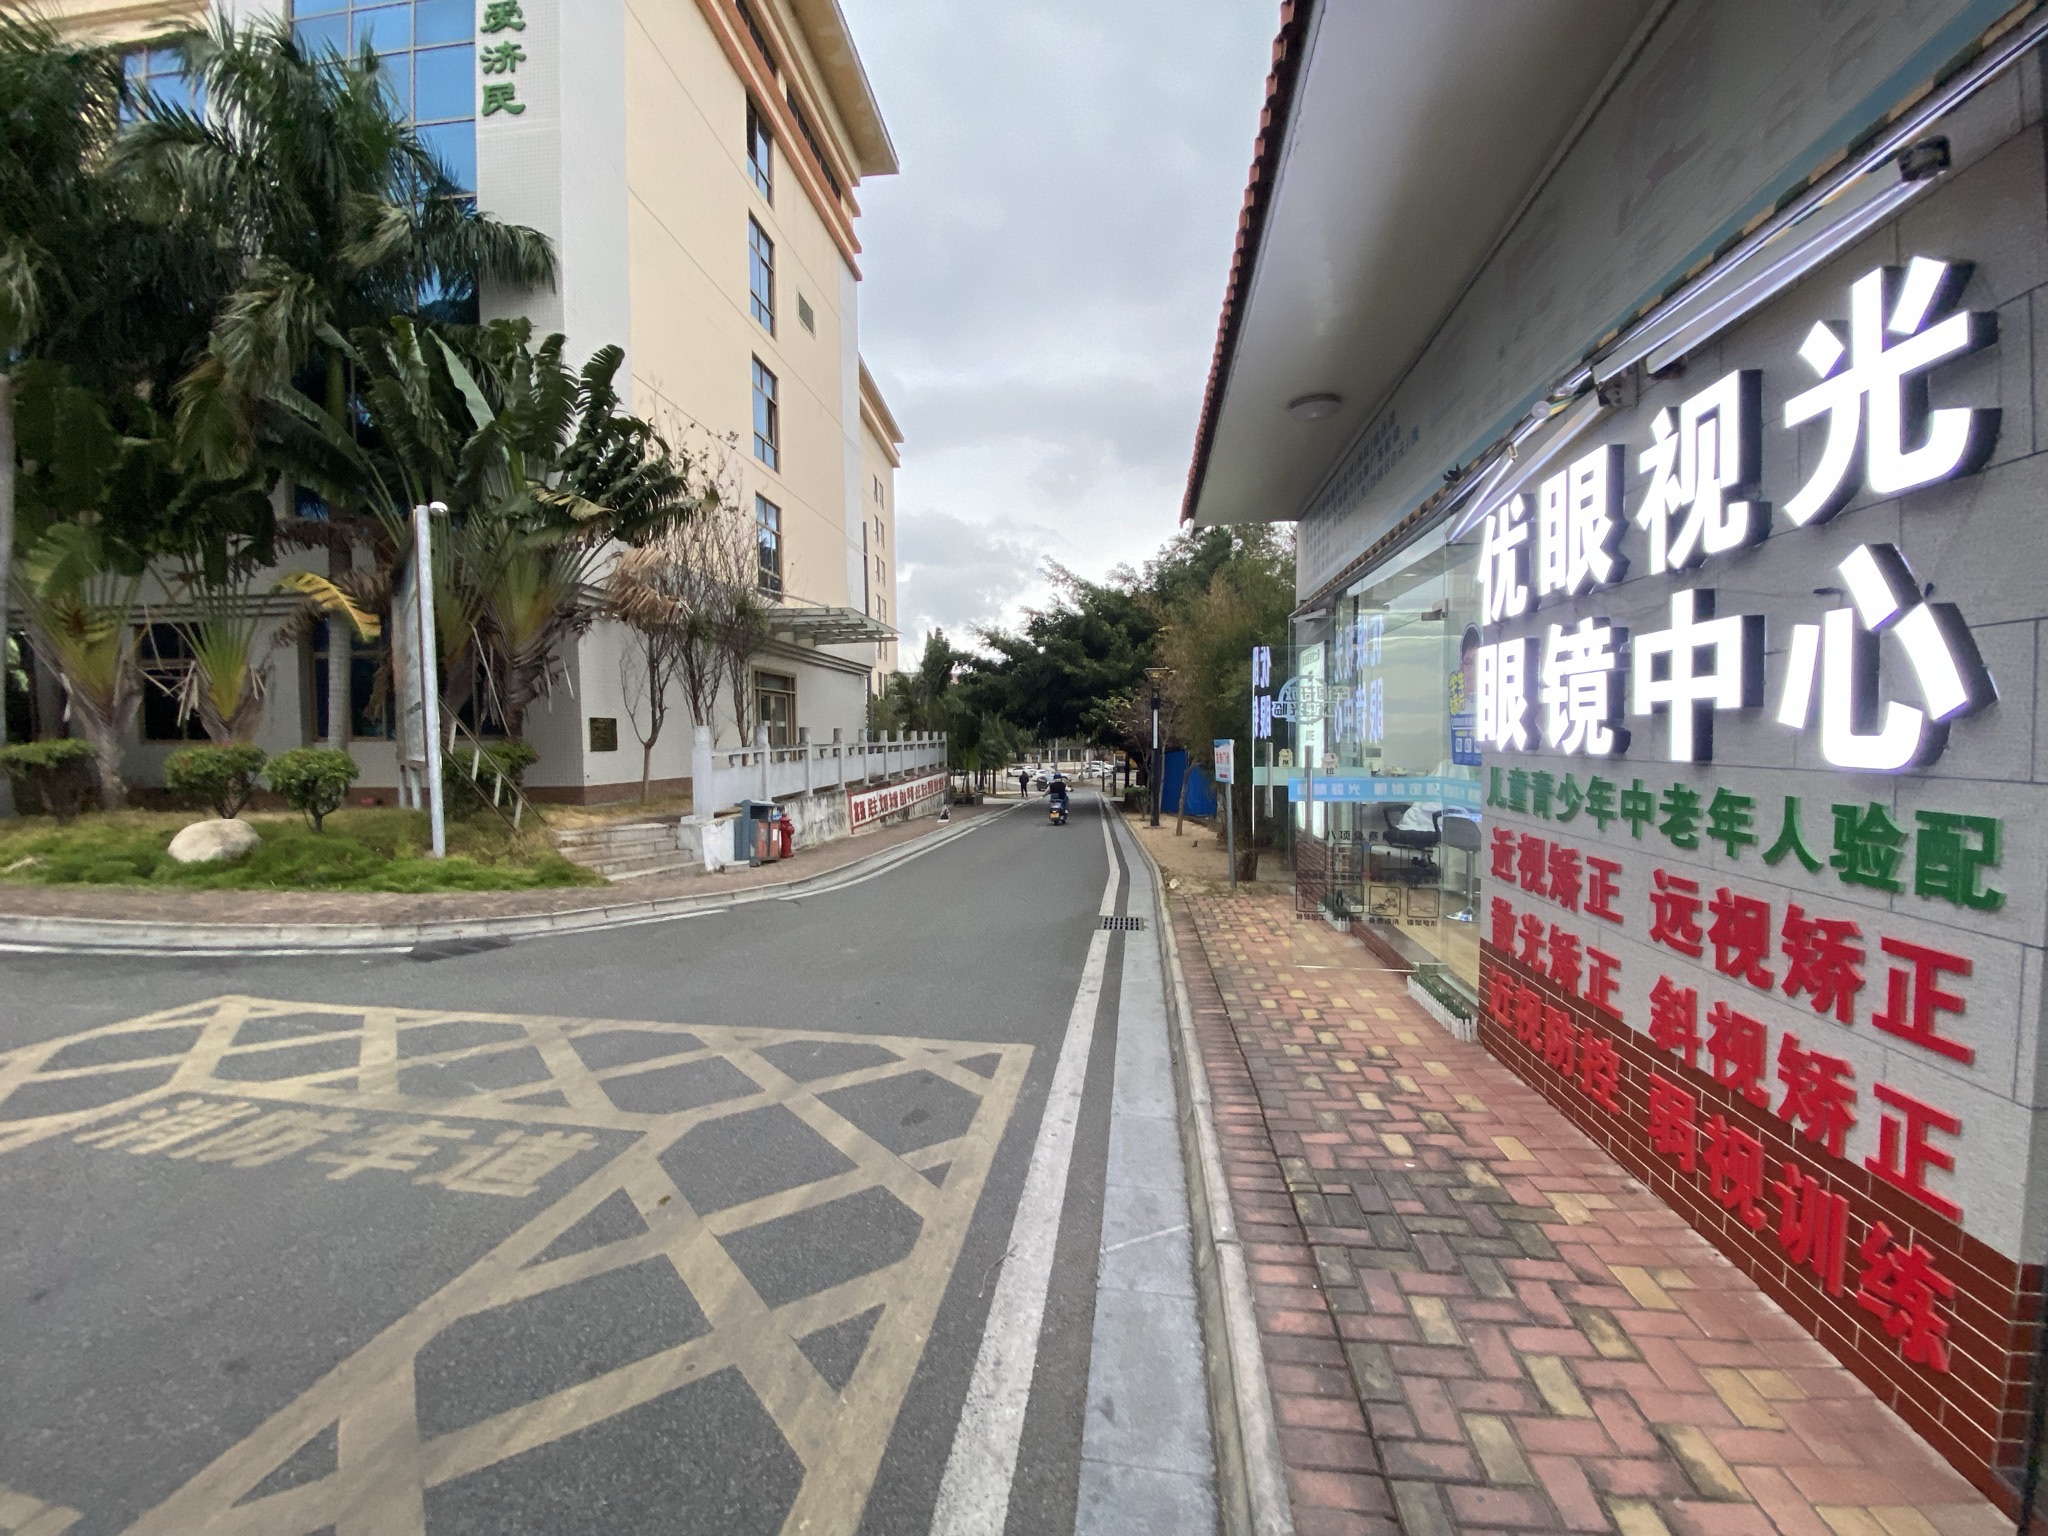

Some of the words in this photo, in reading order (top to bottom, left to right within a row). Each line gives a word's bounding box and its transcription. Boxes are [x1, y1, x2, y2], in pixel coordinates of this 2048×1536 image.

[1477, 255, 1974, 626] 优眼视光
[1477, 544, 1969, 770] 眼镜中心
[1486, 766, 2006, 910] 儿童青少年中老年人验配
[1491, 826, 1624, 924] 近视矫正
[1648, 868, 1975, 1065] 远视矫正
[71, 1099, 601, 1198] 消防车道
[1488, 964, 1622, 1115] 近视防控
[1647, 1072, 1957, 1372] 弱视训练
[1491, 896, 1624, 1021] 散光矫正
[1648, 974, 1963, 1223] 斜视矫正
